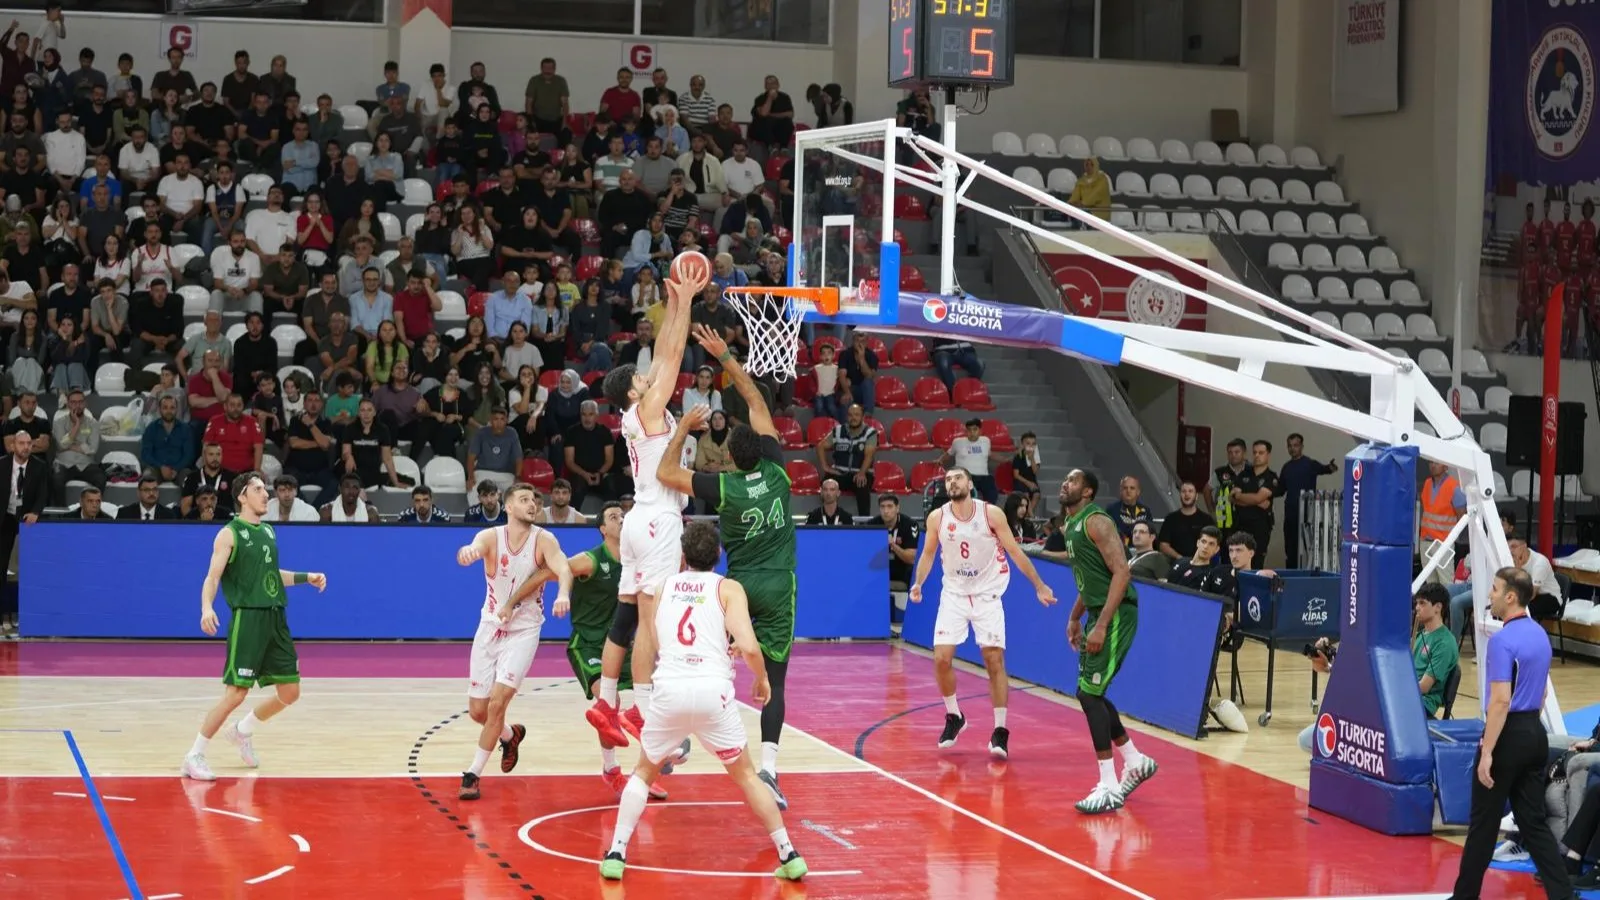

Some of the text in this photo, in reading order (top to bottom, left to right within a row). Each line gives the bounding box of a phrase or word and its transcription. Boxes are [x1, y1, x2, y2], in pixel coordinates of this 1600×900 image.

[169, 24, 192, 50] G
[903, 28, 913, 76] 5
[970, 28, 994, 76] 5
[630, 45, 652, 69] G
[741, 497, 785, 541] 24
[262, 545, 272, 563] 2
[677, 606, 697, 646] 6
[1338, 719, 1385, 753] TÜRKİYE
[1337, 741, 1385, 777] SİGORTA
